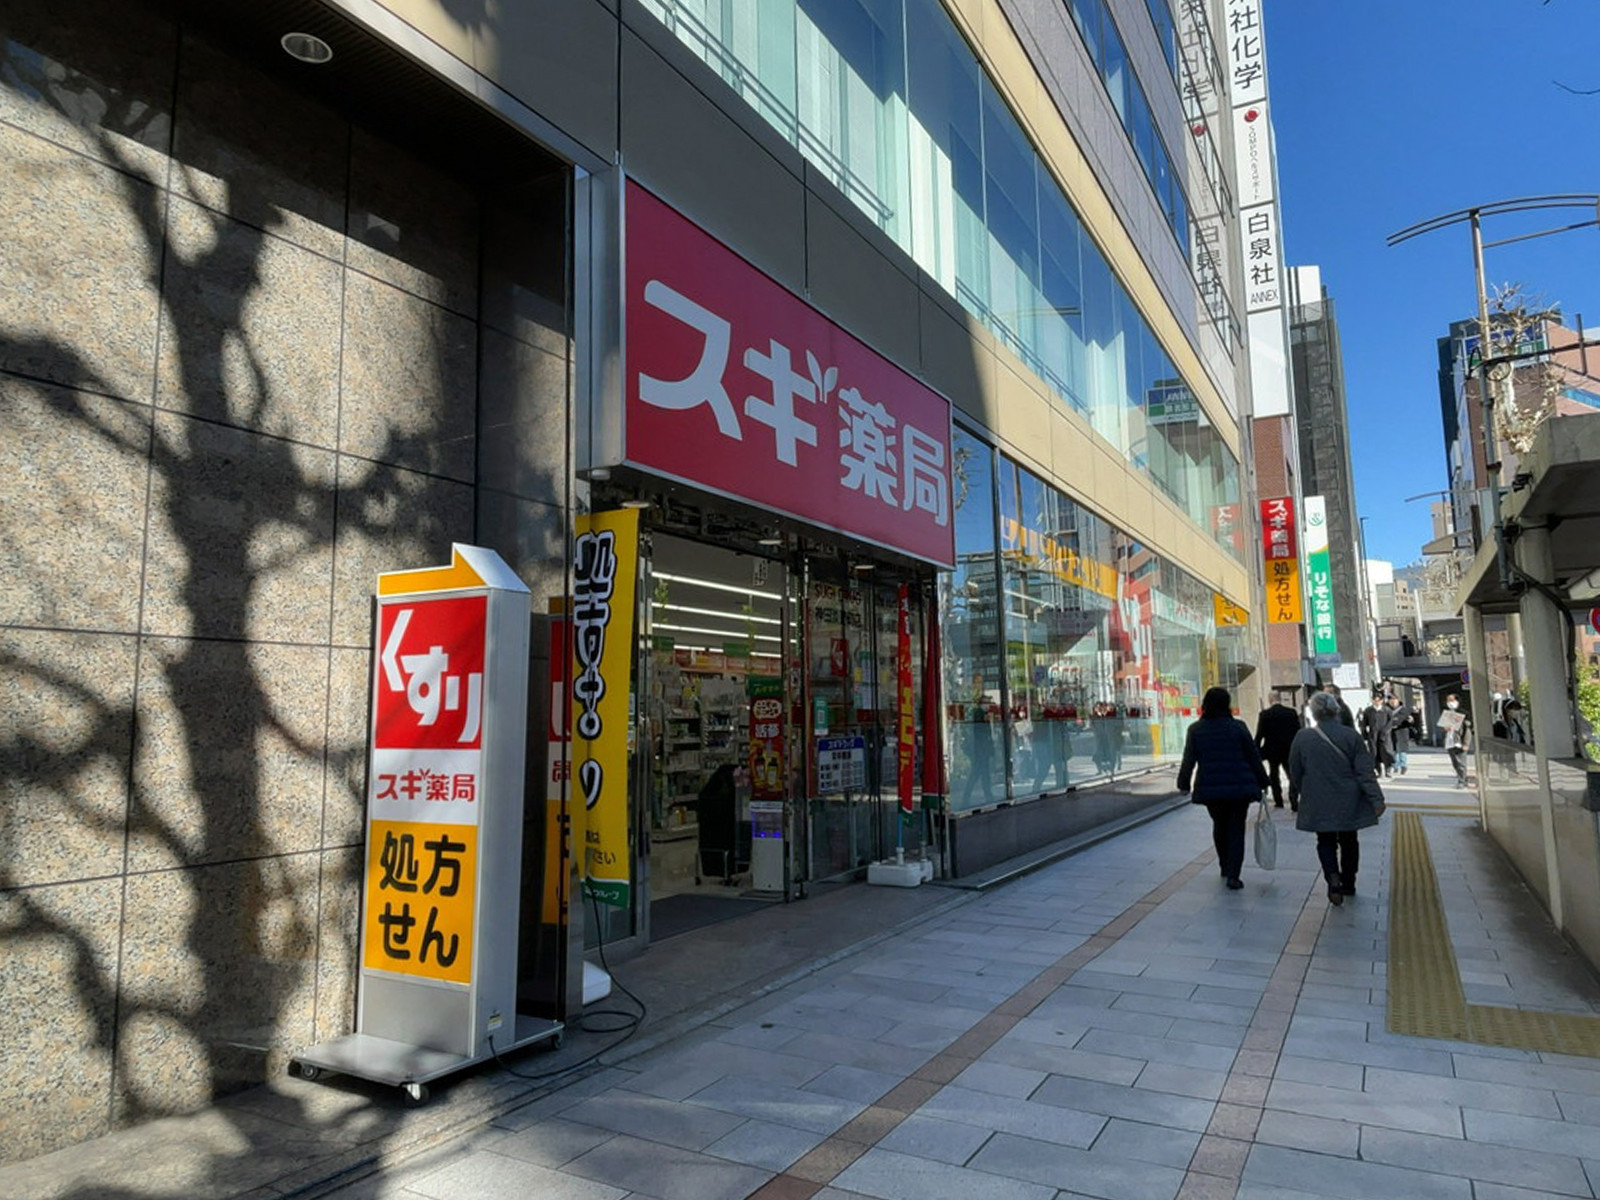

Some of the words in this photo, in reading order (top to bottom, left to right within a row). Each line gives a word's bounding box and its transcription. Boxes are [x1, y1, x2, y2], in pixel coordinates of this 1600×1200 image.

[1248, 212, 1275, 285] 白泉社
[1250, 289, 1279, 304] ANNEX
[639, 279, 947, 526] スギ薬局
[1268, 500, 1289, 558] スギ薬局
[1273, 561, 1293, 621] 処方せん
[1314, 571, 1332, 640] りそな銀行
[381, 609, 482, 743] くすり
[376, 768, 476, 802] スギ薬局
[379, 830, 466, 898] 処方
[378, 902, 458, 968] せん
